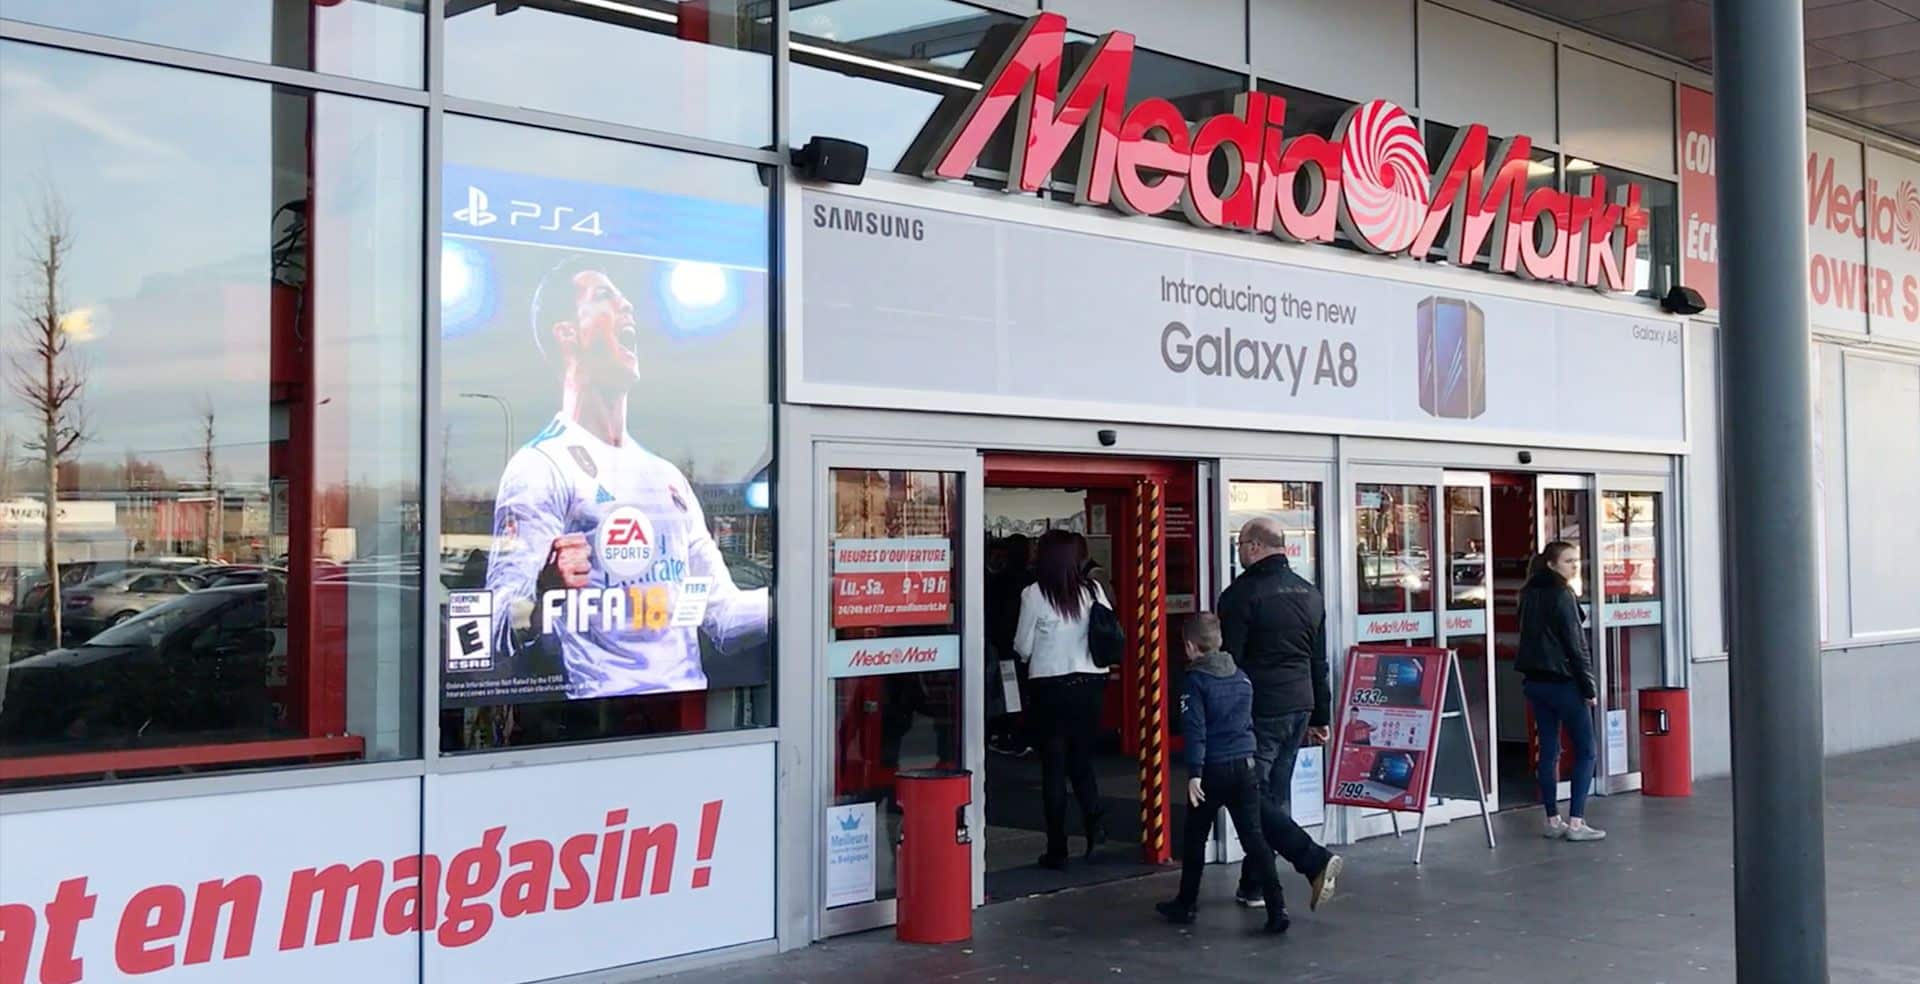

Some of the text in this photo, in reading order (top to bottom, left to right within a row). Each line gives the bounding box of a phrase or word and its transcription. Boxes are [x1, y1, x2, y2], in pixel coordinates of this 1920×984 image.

[510, 200, 602, 237] PS4
[813, 204, 925, 242] SAMSUNG
[1160, 276, 1357, 325] Introducing the new
[1810, 254, 1894, 317] OWER
[1632, 324, 1679, 345] Galaxy A8
[1160, 321, 1358, 396] Galaxy A8
[607, 519, 648, 545] EA
[605, 547, 650, 560] SPORTS
[839, 549, 946, 563] HEURES D'OUVERTURE
[685, 583, 707, 594] FIFA
[902, 577, 911, 594] 9
[922, 577, 935, 593] 19
[937, 576, 946, 593] h
[542, 587, 626, 635] FIFA
[629, 586, 669, 632] 18
[457, 620, 484, 656] E
[449, 659, 491, 669] ESRB
[901, 647, 938, 663] Markt
[114, 874, 263, 975] en
[278, 808, 679, 949] magasin
[691, 800, 724, 889] !
